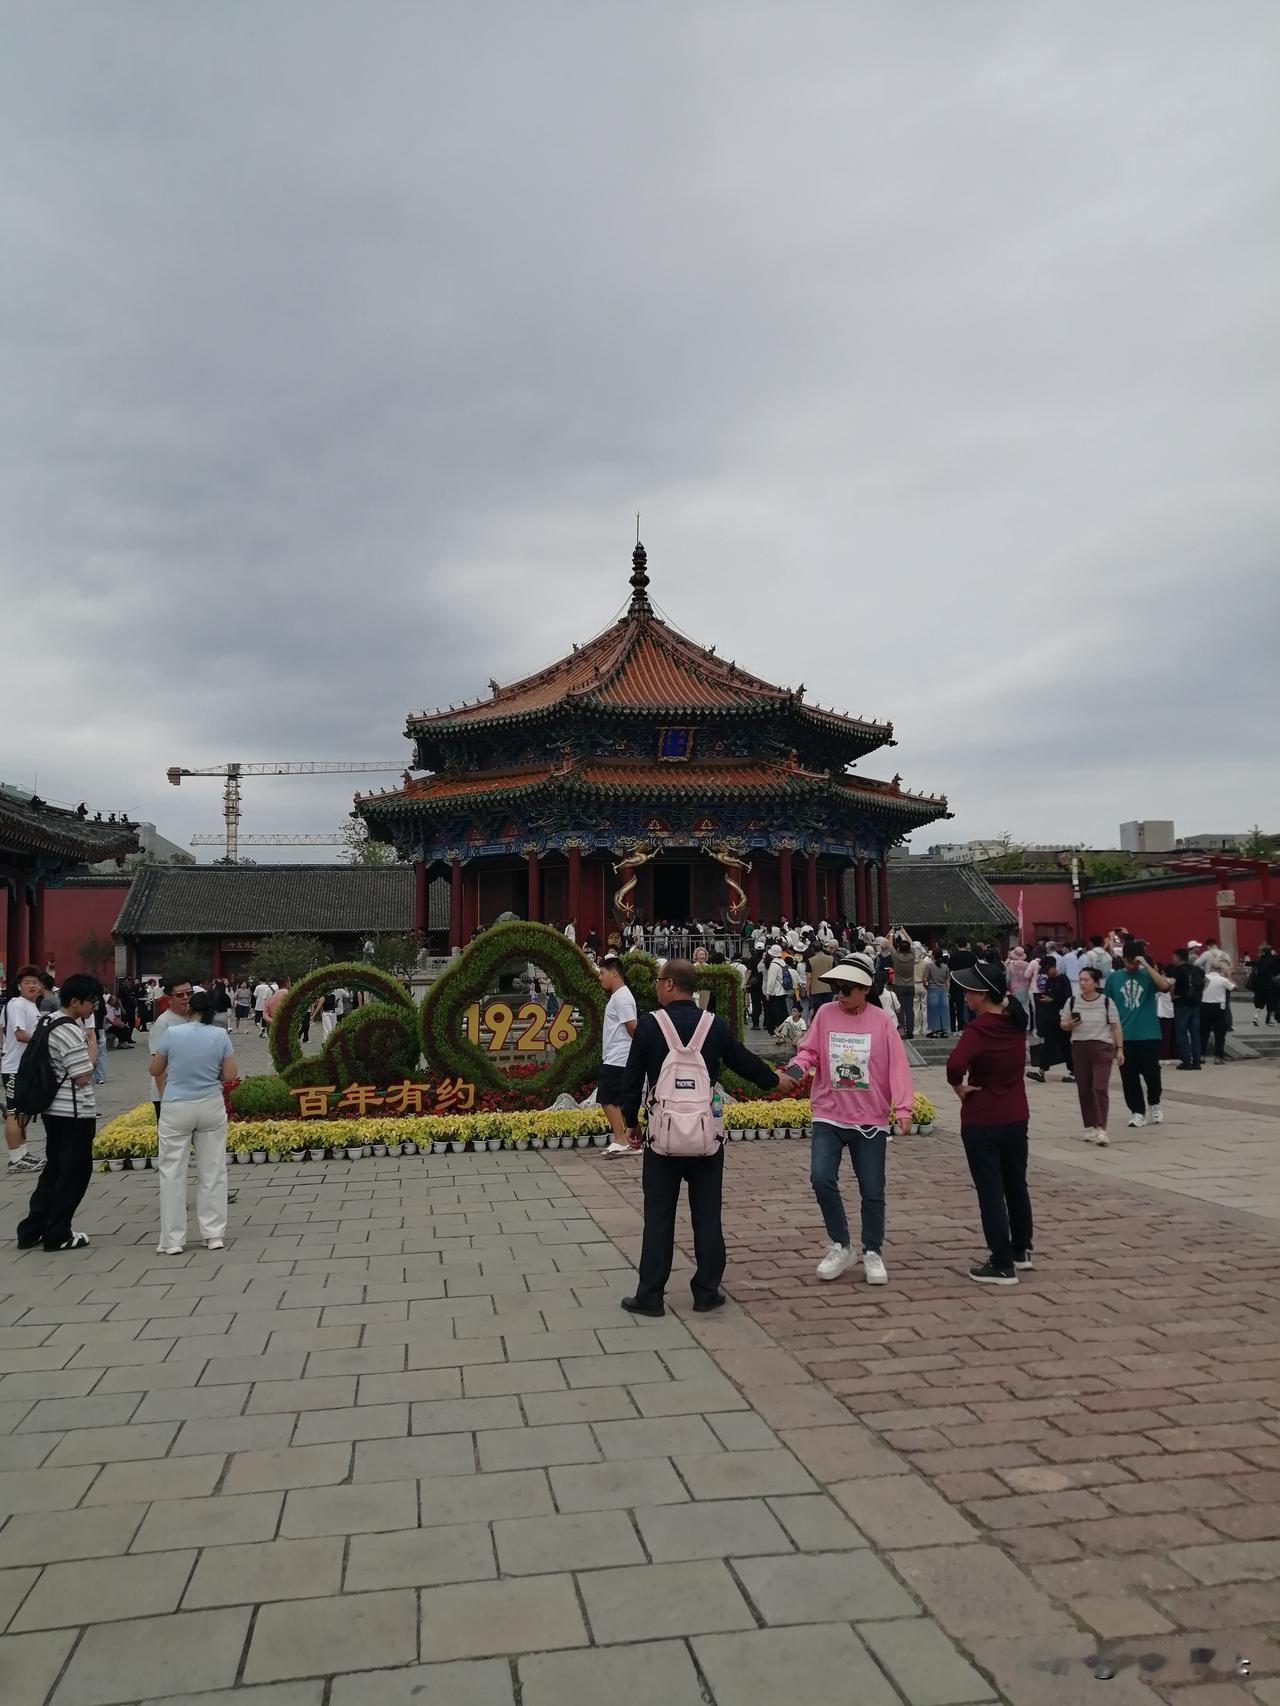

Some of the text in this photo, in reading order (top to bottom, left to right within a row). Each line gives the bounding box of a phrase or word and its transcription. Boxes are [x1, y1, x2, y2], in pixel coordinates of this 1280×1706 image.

[462, 1001, 578, 1051] 1926
[289, 1077, 476, 1117] 百年有约
